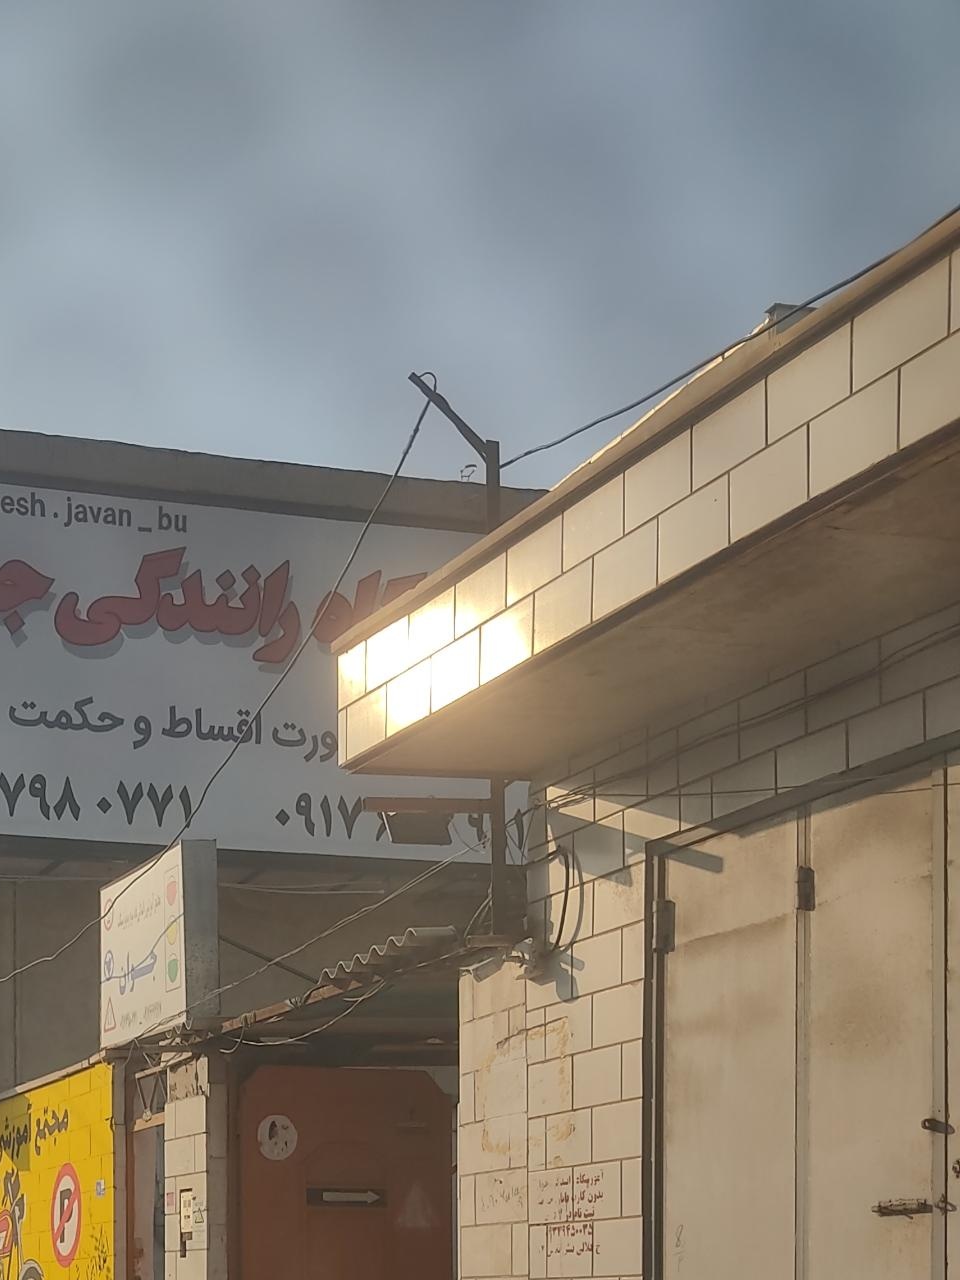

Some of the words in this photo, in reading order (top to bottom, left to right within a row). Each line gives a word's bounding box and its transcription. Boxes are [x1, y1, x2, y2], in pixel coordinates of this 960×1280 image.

[54, 546, 300, 664] رانندگی
[8, 697, 124, 733] حکمت
[132, 713, 152, 750] و
[161, 704, 262, 747] اقساط
[271, 721, 338, 763] ورت
[95, 778, 195, 832] ۰۷۷۱
[275, 792, 362, 840] ۰۹۱۷
[35, 1106, 69, 1156] مجتمع
